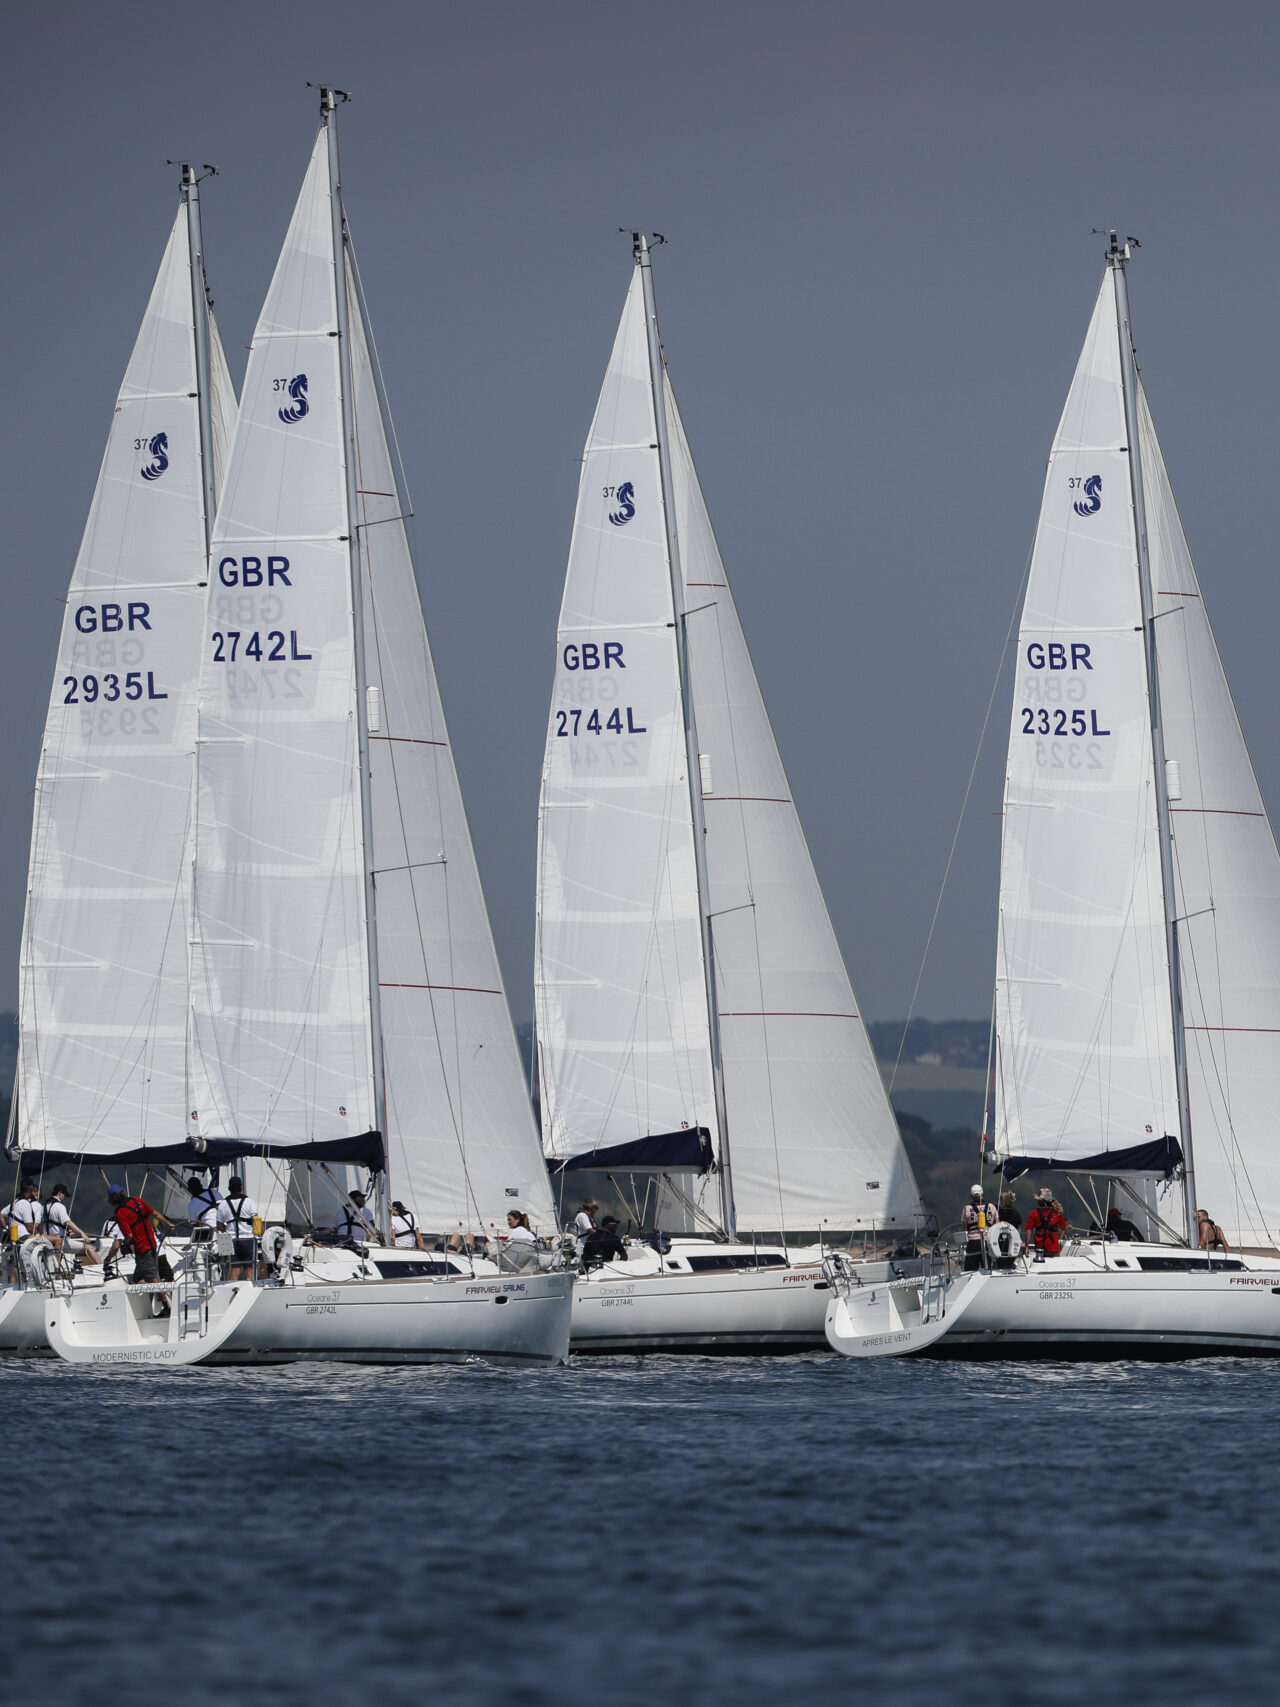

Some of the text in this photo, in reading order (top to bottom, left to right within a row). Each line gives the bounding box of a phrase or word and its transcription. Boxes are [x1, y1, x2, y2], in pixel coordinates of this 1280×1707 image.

[273, 378, 287, 391] 37
[134, 438, 148, 450] 37
[1068, 477, 1081, 488] 37
[602, 486, 615, 498] 37
[219, 556, 292, 587] GBR
[75, 602, 152, 633] GBR
[211, 630, 312, 662] 2742L
[563, 642, 626, 671] GBR
[1027, 643, 1094, 670] GBR
[63, 671, 168, 704] 2935L
[556, 707, 647, 737] 2744L
[1021, 707, 1111, 736] 2325L
[783, 1273, 826, 1283] FAIRVIEW
[1066, 1278, 1077, 1288] 37
[1229, 1278, 1280, 1286] FAIRVIEW
[466, 1284, 526, 1294] FAIRVIEW SAILING
[626, 1284, 635, 1294] 37
[332, 1290, 340, 1302] 37
[1040, 1291, 1075, 1300] GBR 2325L
[601, 1299, 615, 1307] GBR
[306, 1306, 337, 1315] GBR 2742L
[862, 1332, 912, 1348] APRES LE VENT
[92, 1350, 177, 1364] MODERNISTIC LADY
